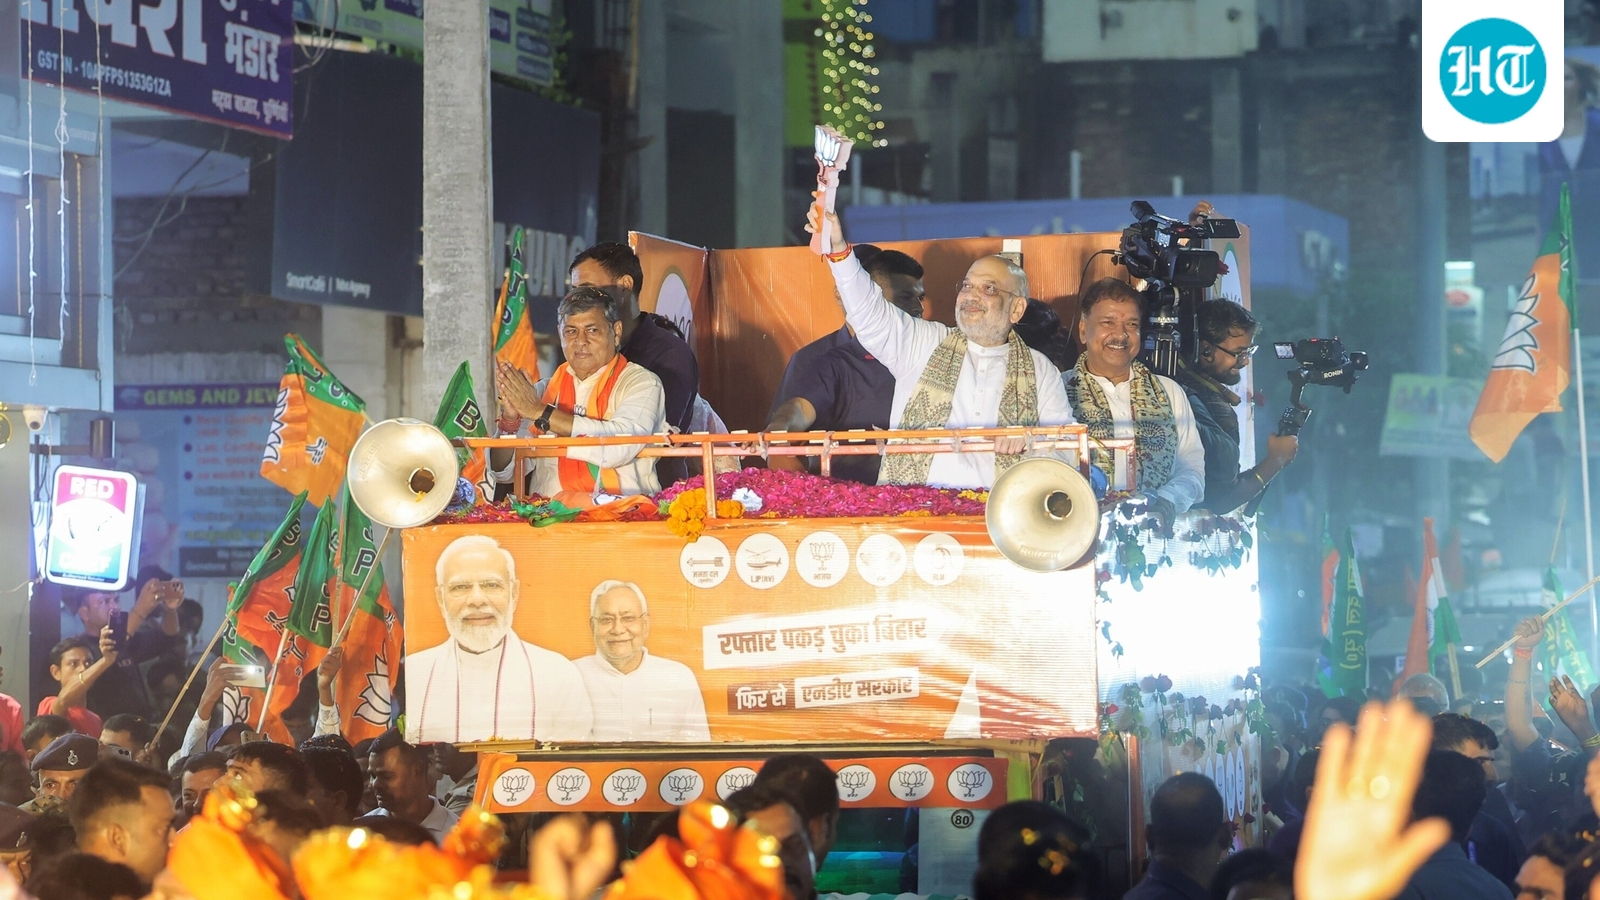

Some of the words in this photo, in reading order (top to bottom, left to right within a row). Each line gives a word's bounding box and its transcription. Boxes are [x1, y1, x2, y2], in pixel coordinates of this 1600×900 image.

[37, 49, 59, 70] GST
[1323, 369, 1344, 379] RONIN
[143, 388, 196, 406] GEMS
[201, 387, 240, 405] AND
[70, 476, 115, 499] RED
[780, 625, 825, 653] पकड़
[829, 622, 870, 653] चुका
[873, 614, 927, 643] बिहार
[735, 686, 771, 710] फिर
[771, 682, 788, 706] से
[800, 677, 854, 703] एनडीए
[855, 676, 913, 697] सरकार
[954, 815, 970, 825] 80
